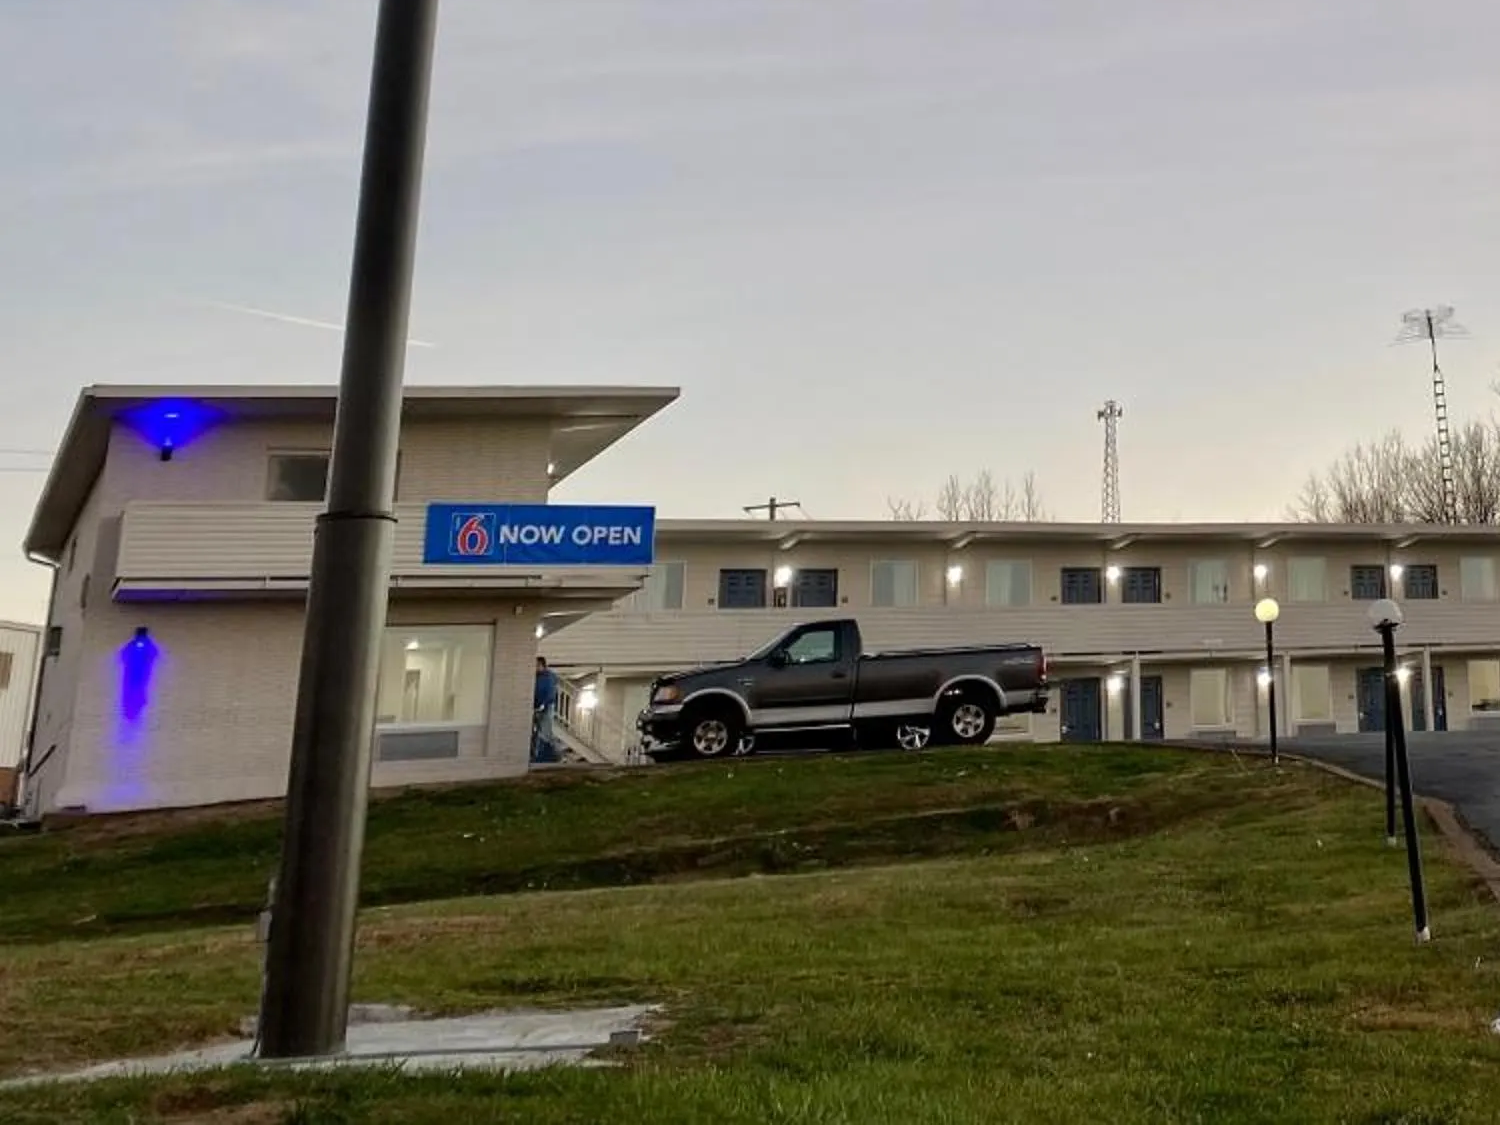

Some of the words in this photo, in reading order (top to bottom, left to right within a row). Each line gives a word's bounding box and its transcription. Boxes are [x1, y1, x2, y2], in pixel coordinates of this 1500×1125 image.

[457, 515, 489, 556] 6
[499, 524, 566, 545] NOW
[571, 525, 642, 546] OPEN
